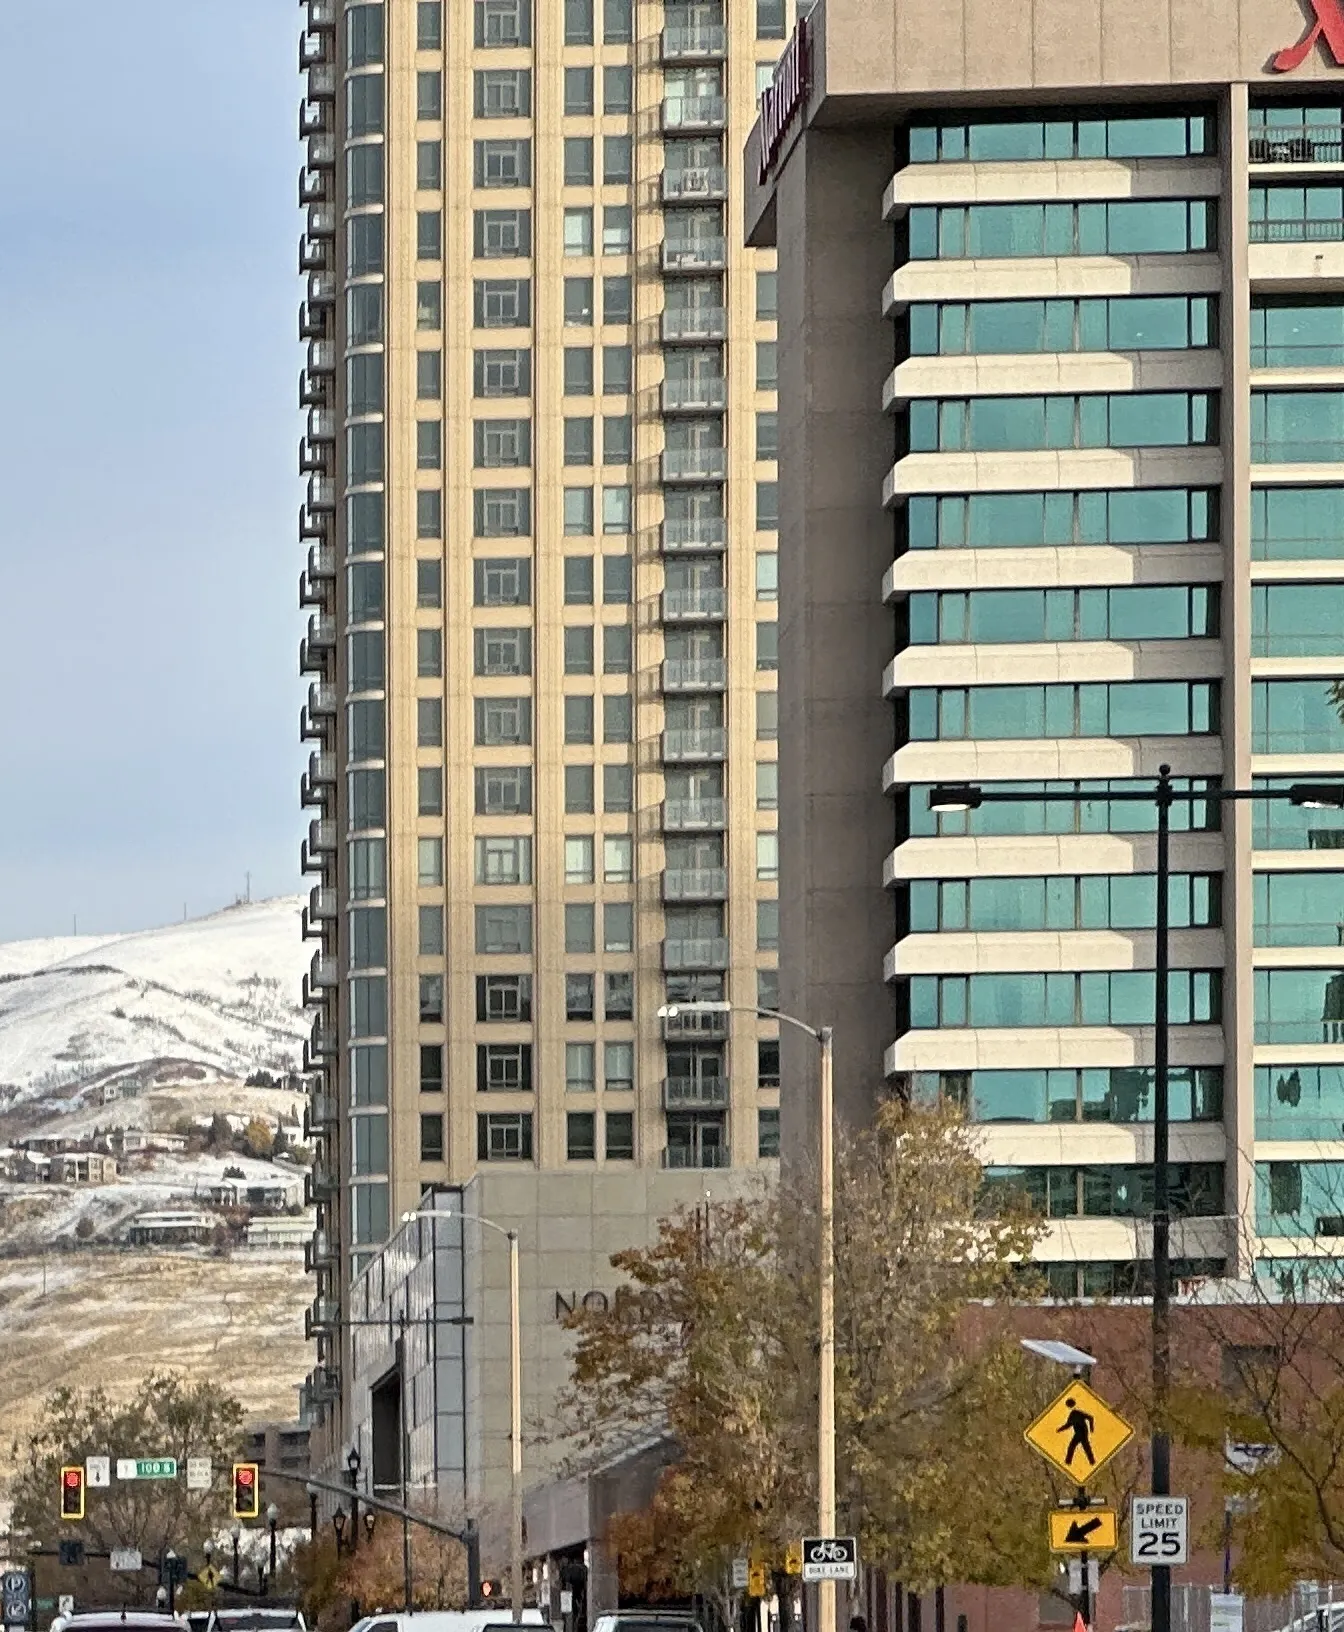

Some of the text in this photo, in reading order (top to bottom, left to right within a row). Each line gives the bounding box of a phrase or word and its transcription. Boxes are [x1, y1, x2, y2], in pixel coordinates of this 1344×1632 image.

[1136, 1503, 1184, 1515] SPEED
[1141, 1517, 1178, 1529] LIMIT
[1138, 1530, 1181, 1556] 25
